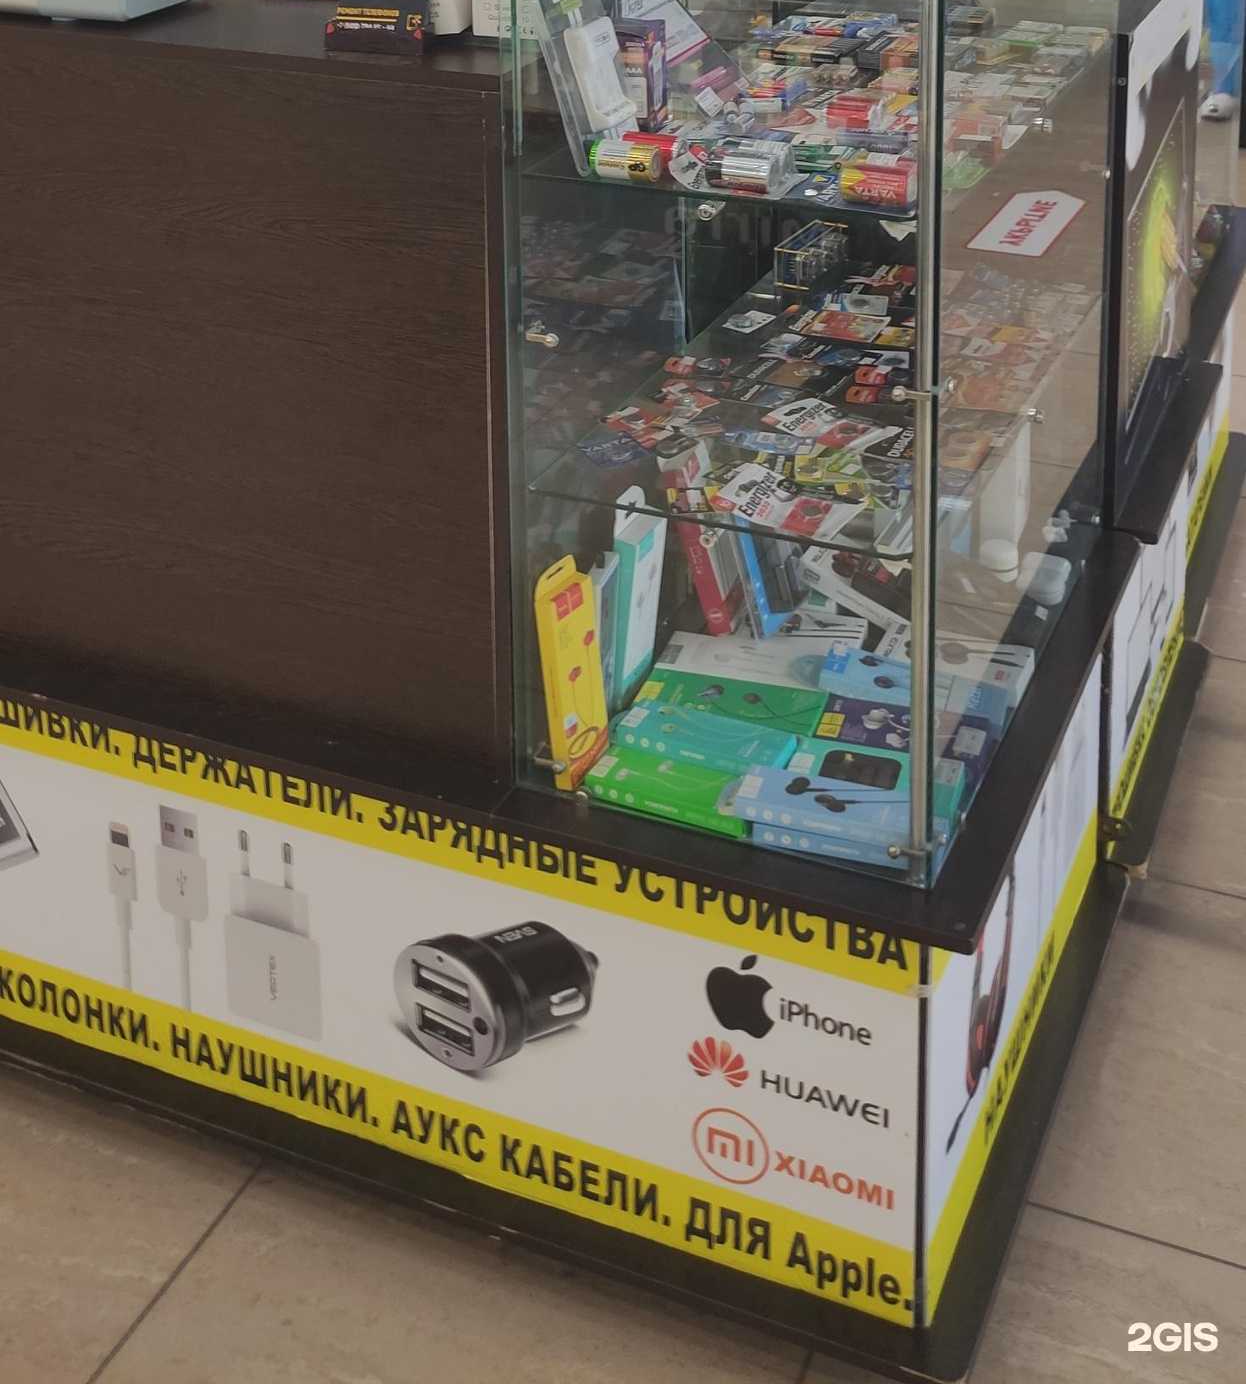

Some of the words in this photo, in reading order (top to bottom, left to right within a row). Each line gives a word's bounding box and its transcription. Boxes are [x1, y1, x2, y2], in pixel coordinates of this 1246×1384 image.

[855, 185, 897, 201] VARTA
[738, 471, 777, 518] Energizer
[133, 734, 364, 824] ДЕРЖАТЕЛИ.
[378, 802, 598, 886] ЗАРЯДНЫЕ
[779, 997, 873, 1046] iPhone
[760, 1069, 890, 1129] HUAWEI
[170, 1022, 380, 1128] НАУШНИКИ.
[391, 1098, 488, 1164] АУКС
[500, 1133, 672, 1226] КАБЕЛИ.
[684, 1196, 772, 1261] ДЛЯ
[785, 1232, 914, 1312] Apple.
[773, 1150, 895, 1210] XIAOMI
